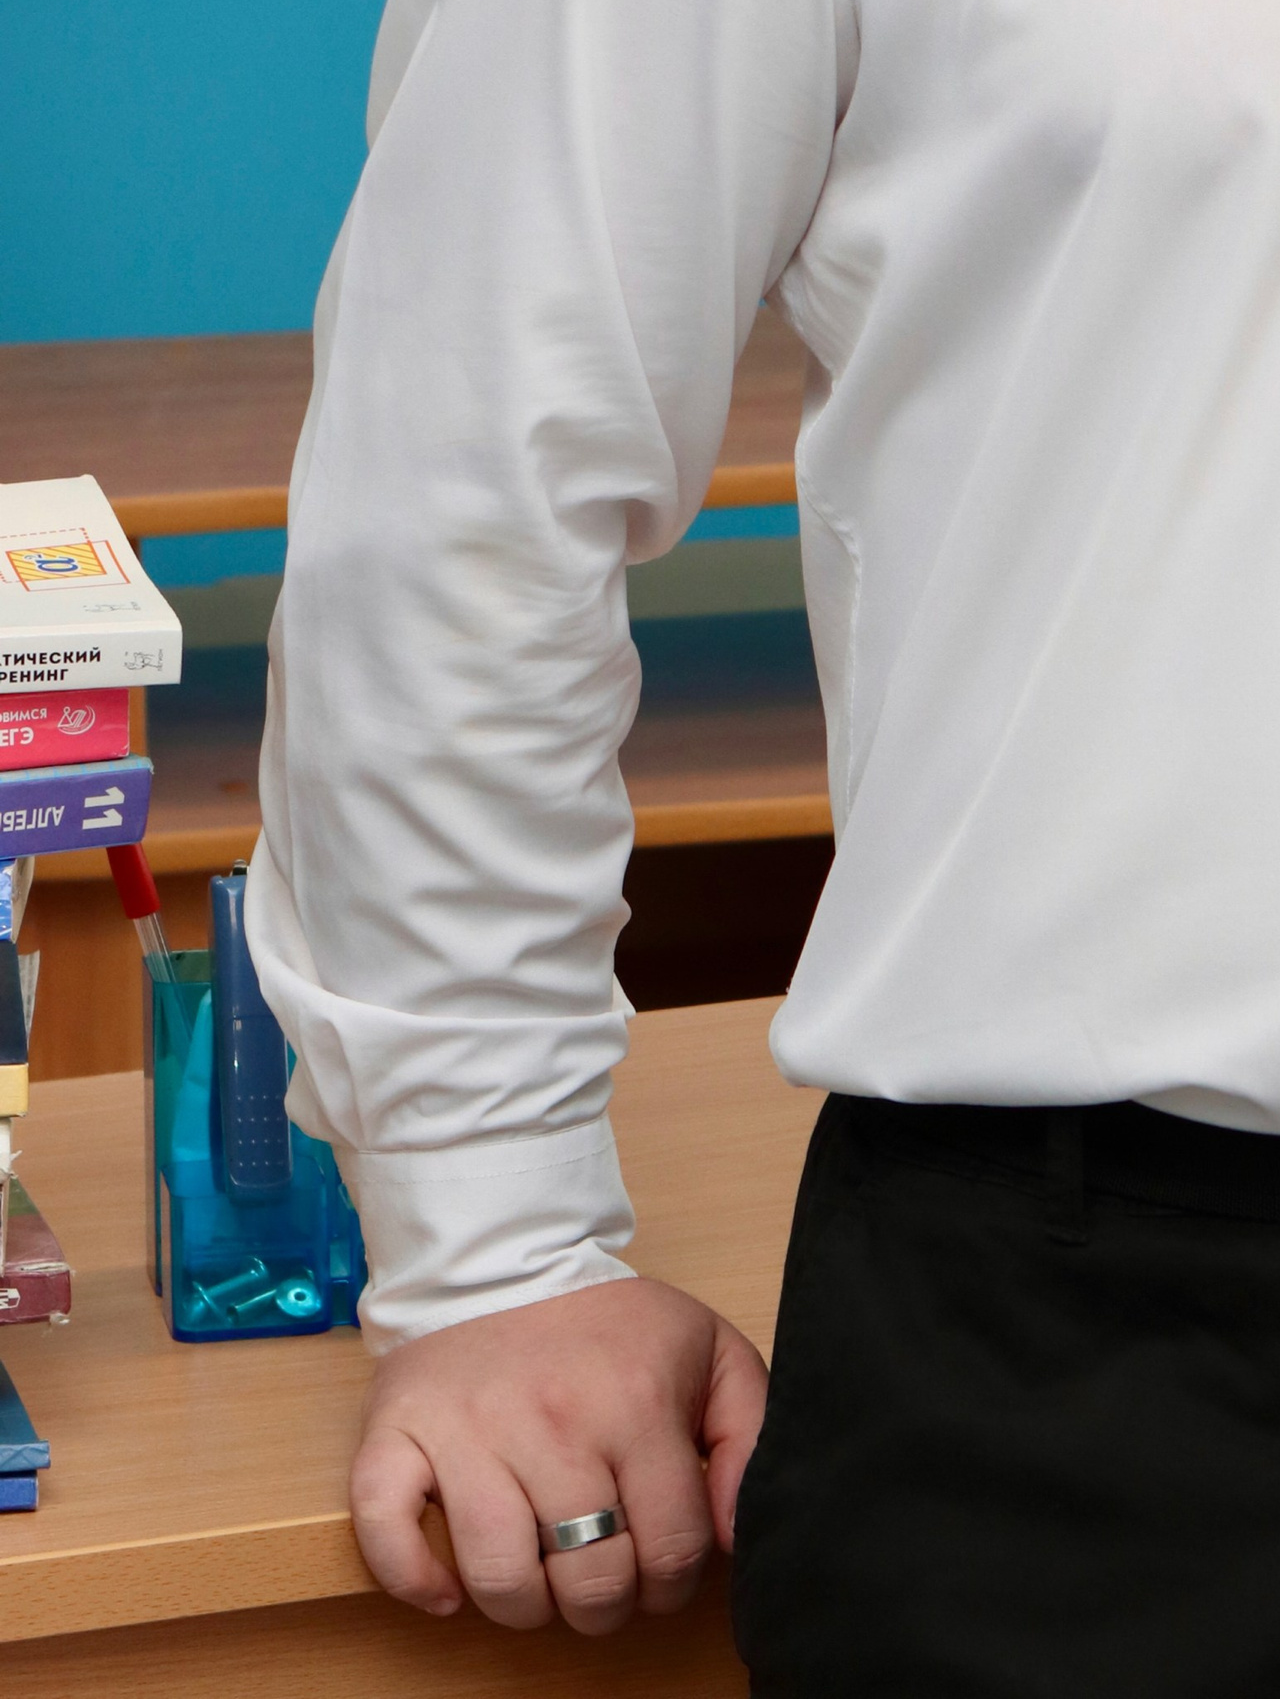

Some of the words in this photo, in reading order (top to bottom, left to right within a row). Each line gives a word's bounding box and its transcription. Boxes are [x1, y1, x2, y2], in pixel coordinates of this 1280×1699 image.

[0, 646, 101, 666] ТИЧЕСКИЙ
[0, 726, 34, 747] ЕГЭ
[0, 805, 65, 832] АЛГЕБ
[82, 786, 125, 830] 11
